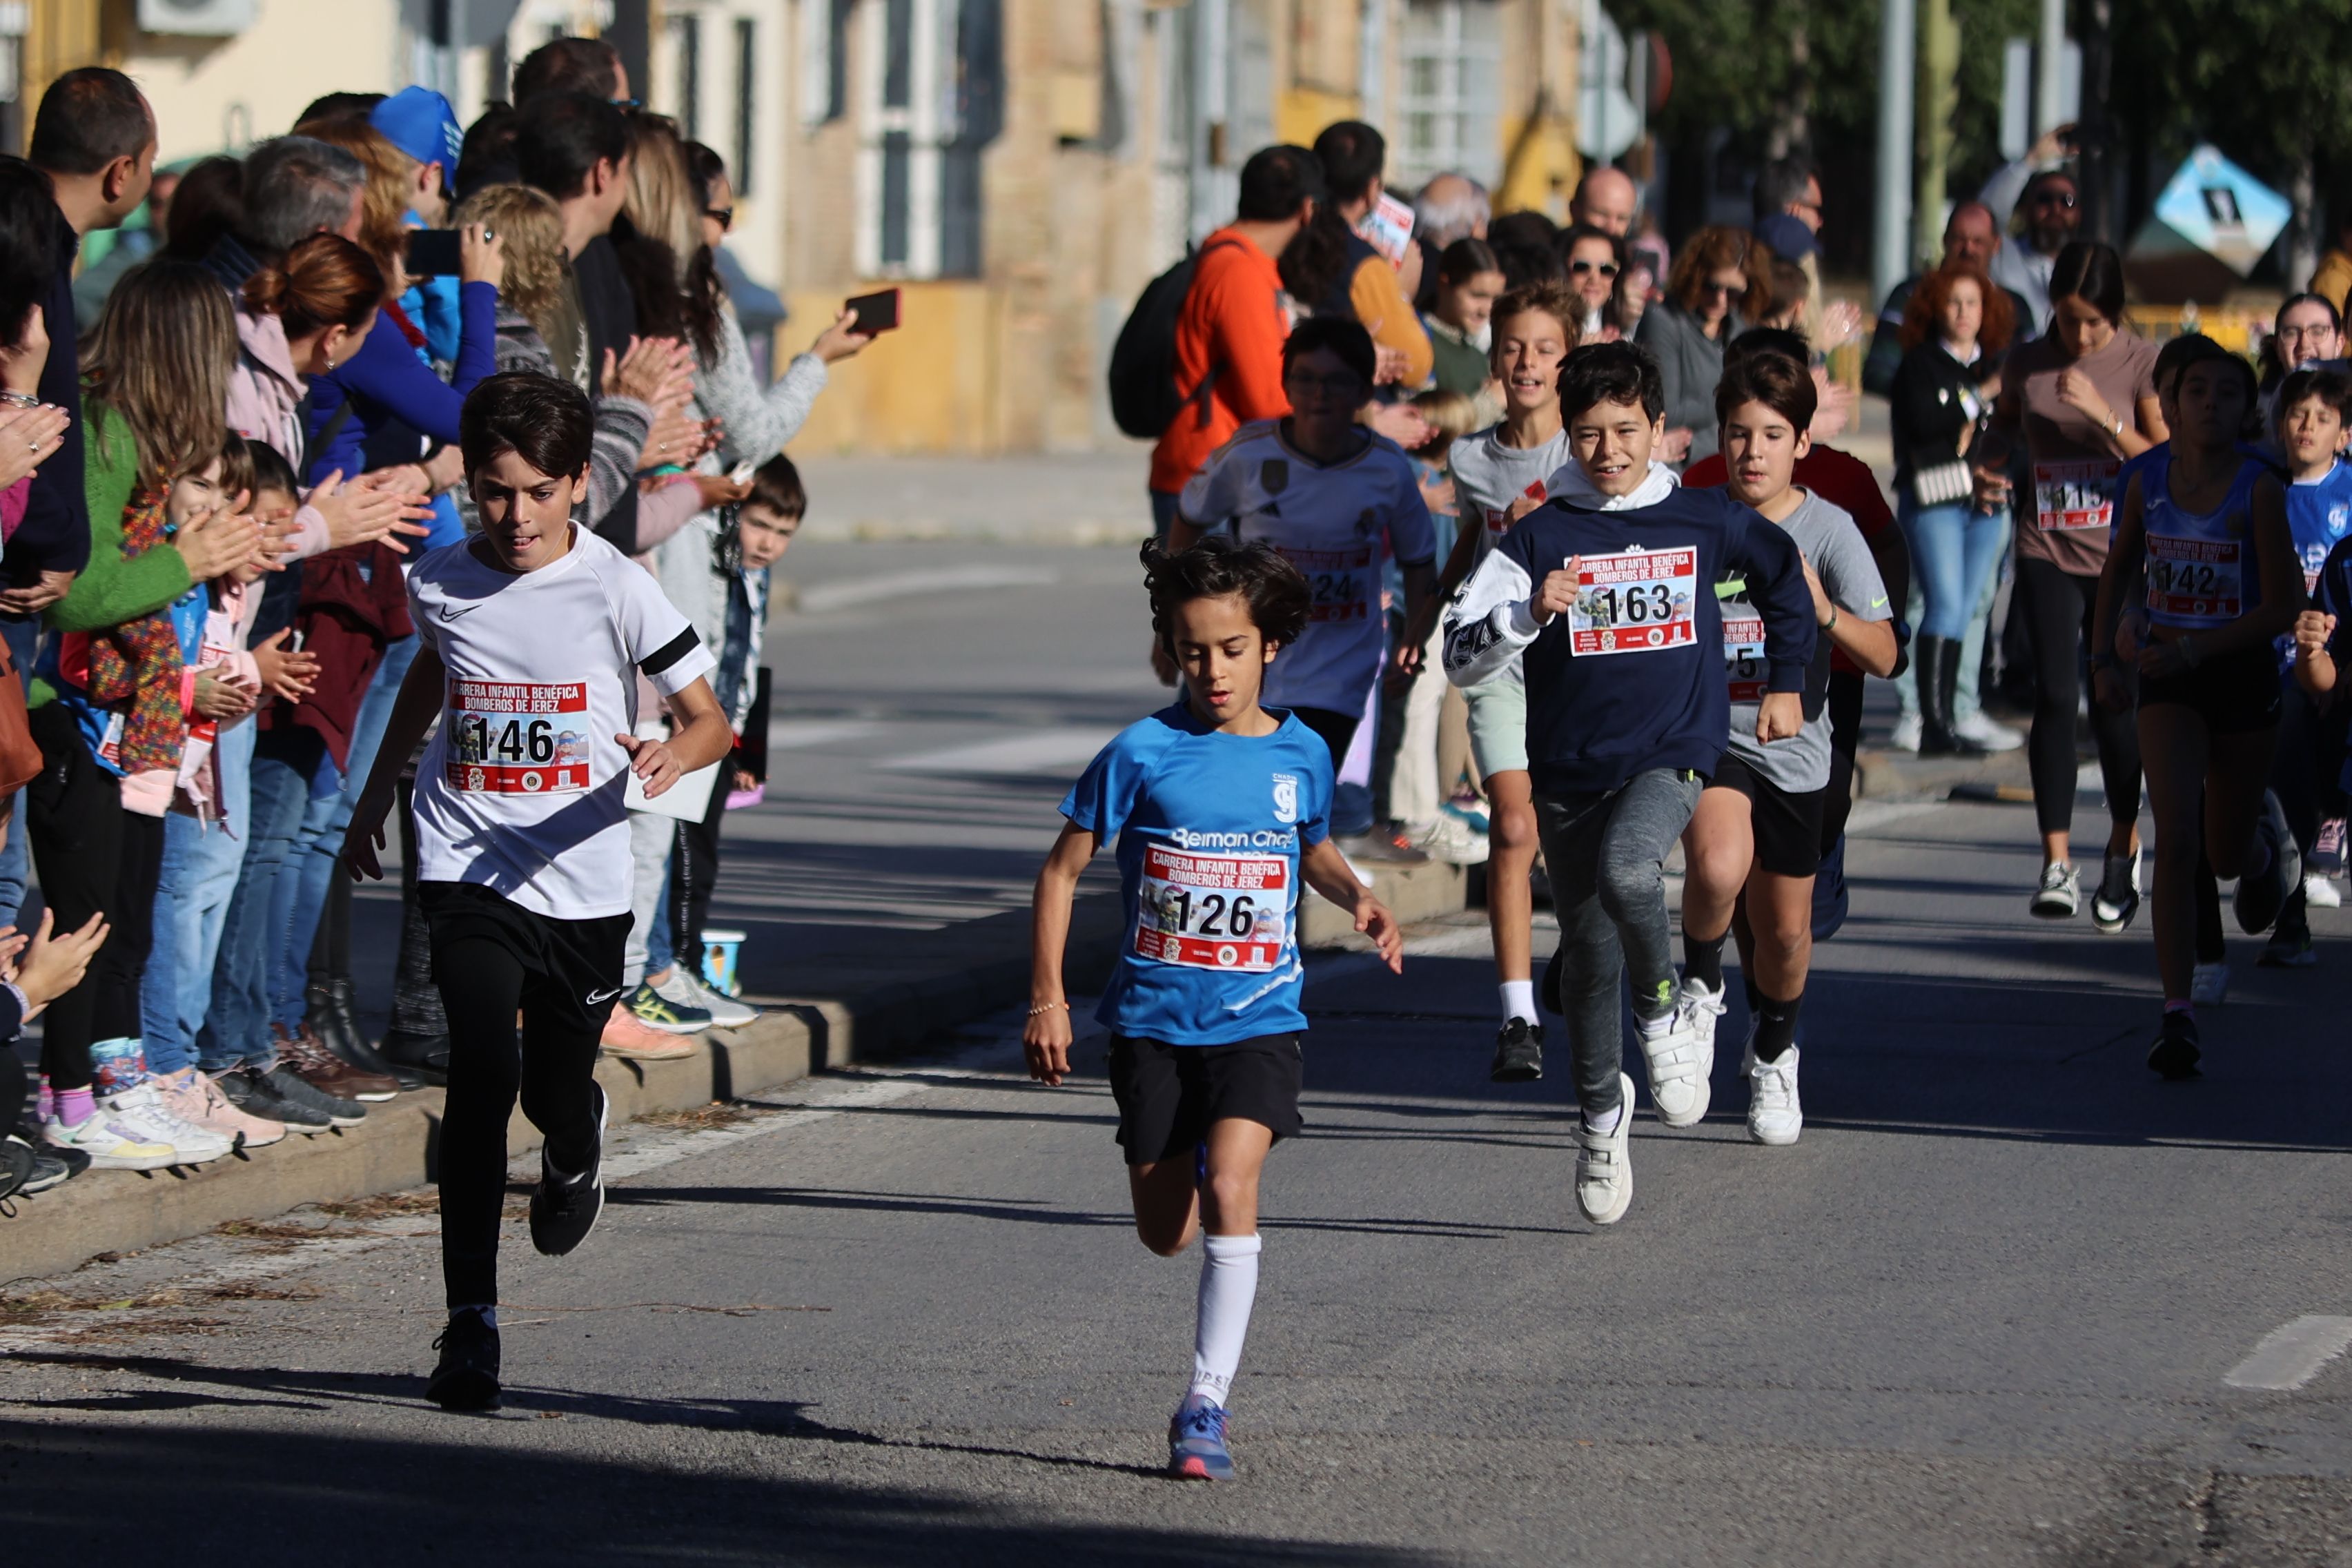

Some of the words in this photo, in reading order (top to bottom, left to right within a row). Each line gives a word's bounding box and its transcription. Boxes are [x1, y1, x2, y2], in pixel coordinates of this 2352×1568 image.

[2057, 484, 2104, 508] 115
[1615, 557, 1651, 571] INFANTIL
[1652, 553, 1689, 567] BENÉFICA
[1594, 570, 1638, 584] BOMBEROS
[1640, 569, 1650, 580] DE
[1652, 566, 1675, 580] JEREZ
[2160, 562, 2214, 596] 142
[1602, 584, 1672, 624] 163
[1723, 634, 1747, 643] BEROS
[1749, 633, 1758, 643] DE
[1726, 621, 1759, 634] INFANTIL
[488, 685, 529, 699] INFANTIL
[531, 685, 579, 700] BENÉFICA
[465, 696, 513, 712] BOMBEROS
[516, 699, 528, 712] DE
[530, 700, 559, 713] JEREZ
[471, 717, 555, 763] 146
[1152, 851, 1194, 872] CARRERA
[1196, 860, 1238, 875] INFANTIL
[1240, 860, 1281, 876] BENÉFICA
[1168, 868, 1221, 886] BOMBEROS
[1222, 874, 1235, 888] DE
[1237, 875, 1264, 890] JEREZ
[1173, 891, 1255, 938] 126
